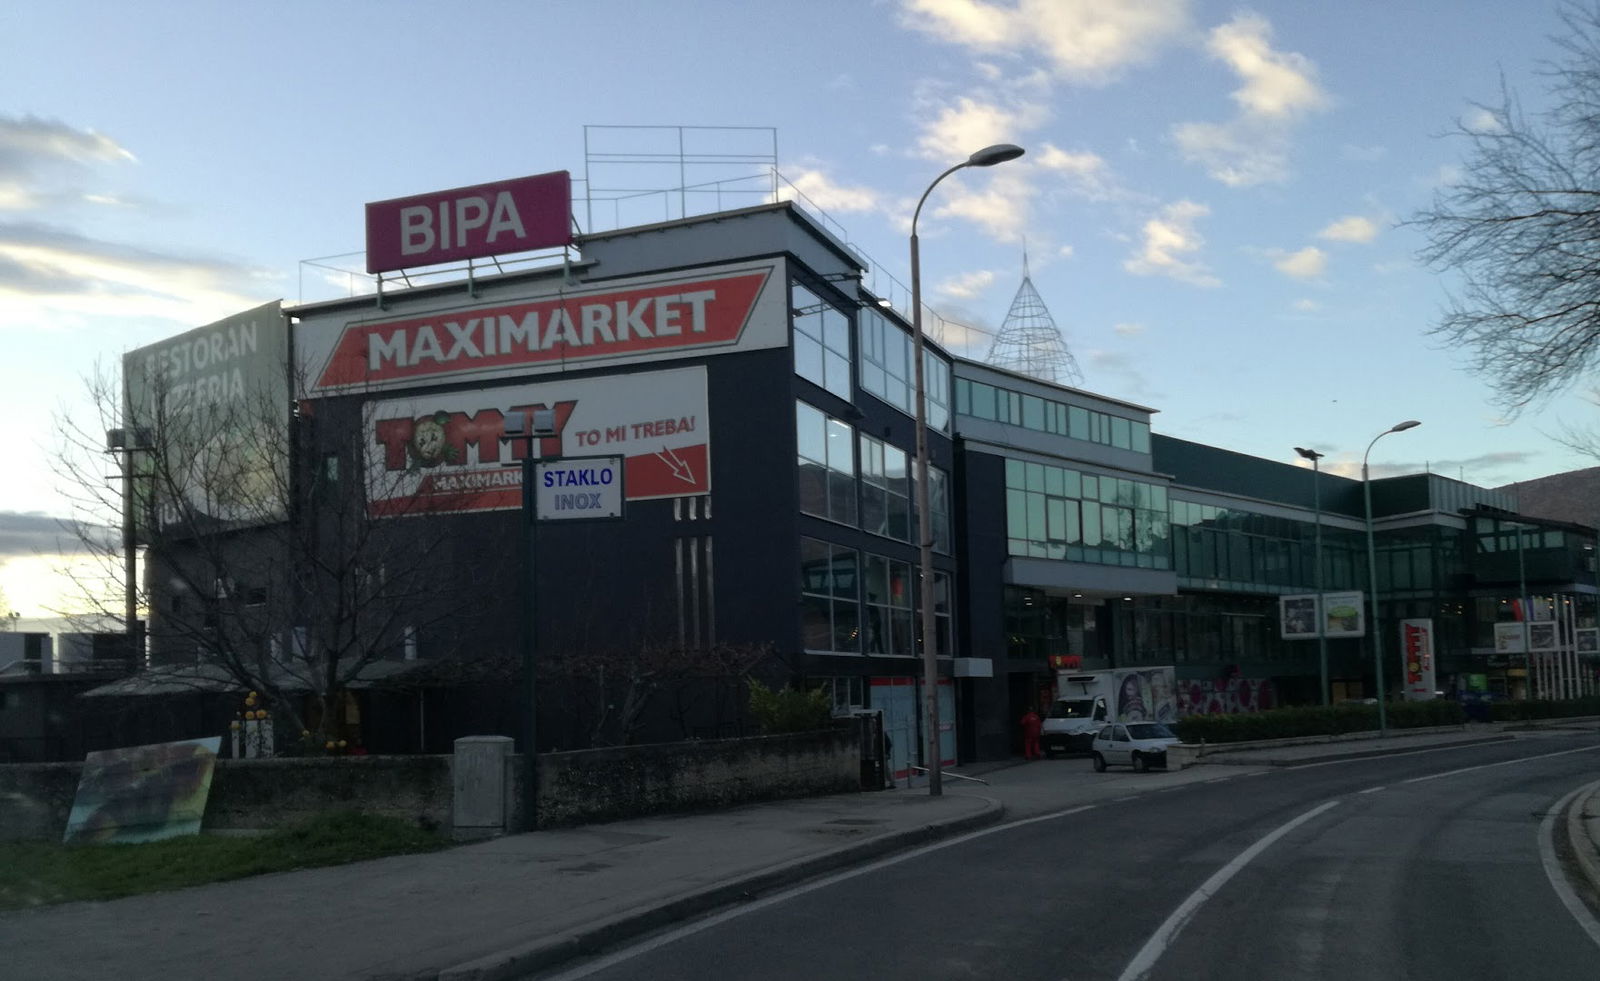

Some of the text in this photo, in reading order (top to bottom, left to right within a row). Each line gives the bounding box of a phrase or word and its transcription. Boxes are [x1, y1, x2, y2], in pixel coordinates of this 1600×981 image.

[401, 191, 527, 256] BIPA
[368, 290, 716, 372] MAXIMARKET
[375, 400, 579, 471] TOMMY
[576, 416, 696, 447] TO MI TREBA!
[433, 470, 523, 490] MAXIMARK
[544, 468, 613, 488] STAKLO
[555, 493, 602, 510] INOX
